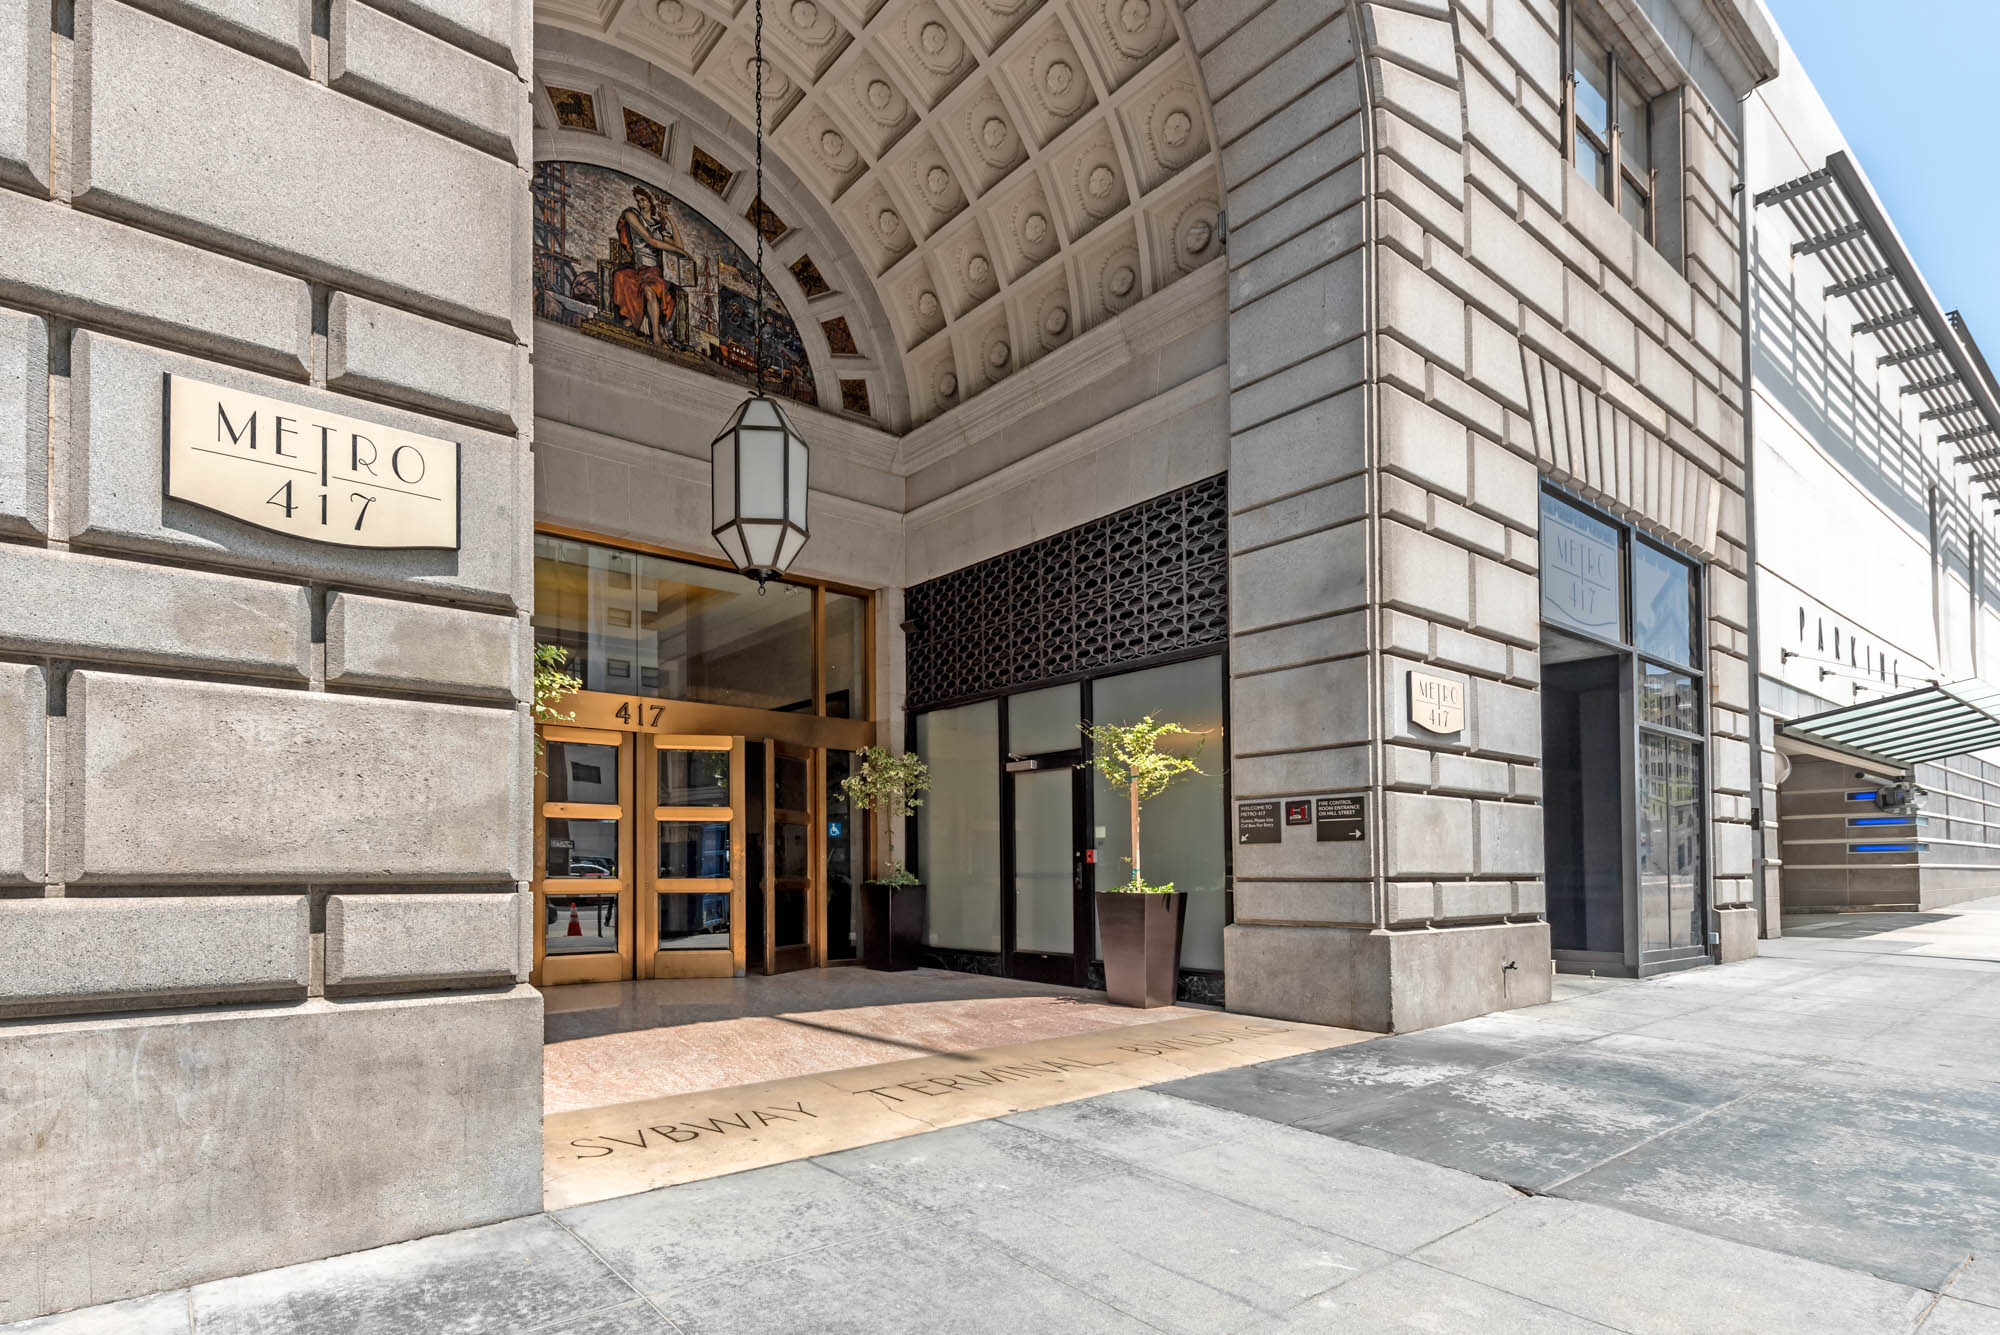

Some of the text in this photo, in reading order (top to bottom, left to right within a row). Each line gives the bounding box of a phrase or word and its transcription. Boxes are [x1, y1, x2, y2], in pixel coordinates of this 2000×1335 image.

[217, 401, 426, 487] METRO
[266, 480, 377, 531] 417
[1799, 606, 1899, 689] PARKING
[615, 702, 666, 727] 417
[1419, 680, 1458, 710] METRO
[1429, 709, 1449, 728] 417
[570, 1101, 818, 1159] SVBWAY
[852, 1056, 1115, 1102] TERMINAL
